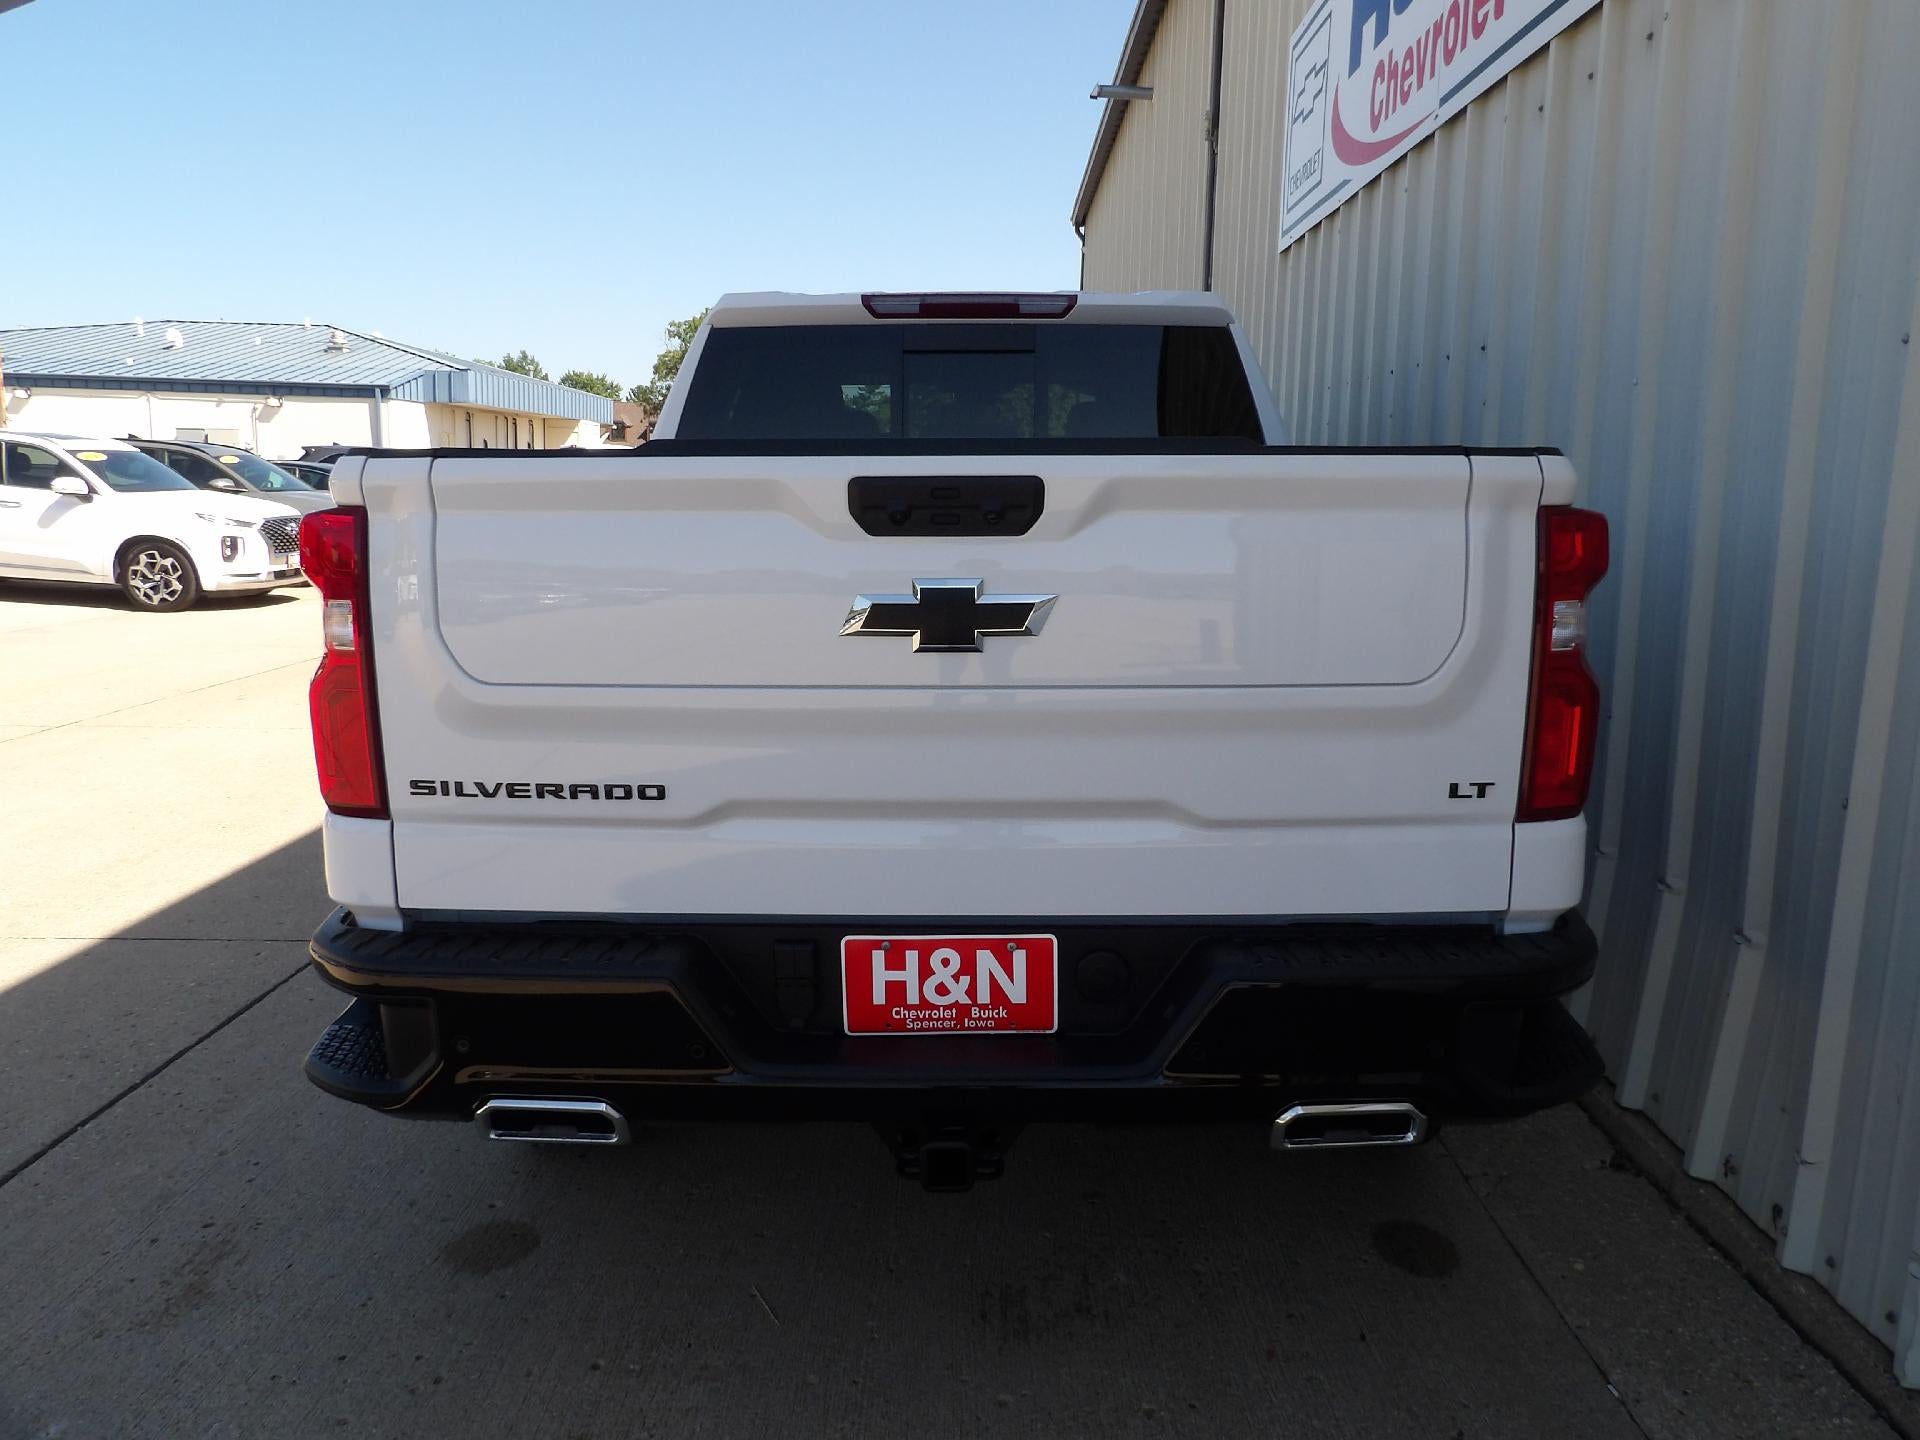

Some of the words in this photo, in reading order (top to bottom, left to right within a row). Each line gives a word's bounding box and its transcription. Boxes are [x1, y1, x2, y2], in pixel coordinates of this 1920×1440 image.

[1289, 147, 1322, 196] CHEVROLET
[409, 780, 666, 800] SILVERADO
[1448, 782, 1496, 798] LT
[871, 947, 1027, 1006] H&N
[891, 1006, 957, 1019] Chevrolet
[971, 1006, 1008, 1018] Buick
[905, 1018, 960, 1030] Spencer,
[964, 1018, 995, 1028] Iowa
